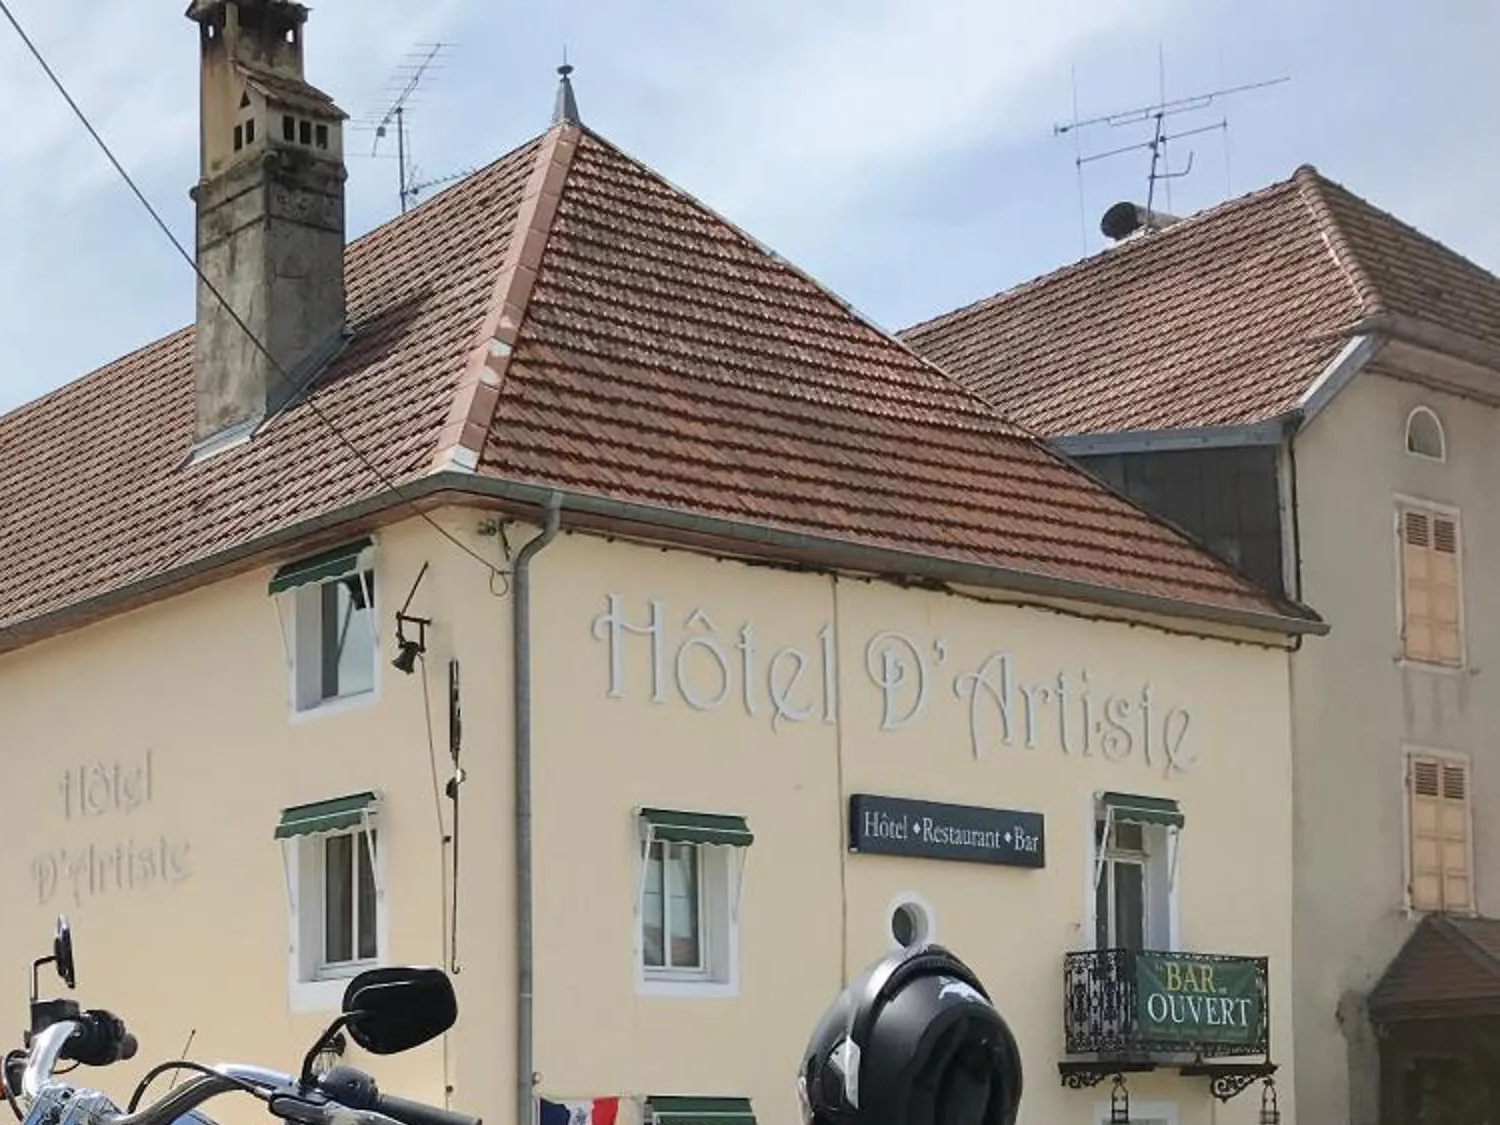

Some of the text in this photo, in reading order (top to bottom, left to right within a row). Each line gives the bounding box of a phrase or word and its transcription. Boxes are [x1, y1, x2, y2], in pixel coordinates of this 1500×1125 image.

[591, 592, 1198, 781] Hôtel D'Artiste
[58, 748, 155, 820] Hôtel
[864, 810, 1039, 853] Hôtel Restaurant Bar
[1165, 961, 1217, 994] BAR
[1147, 993, 1252, 1027] OUVERT
